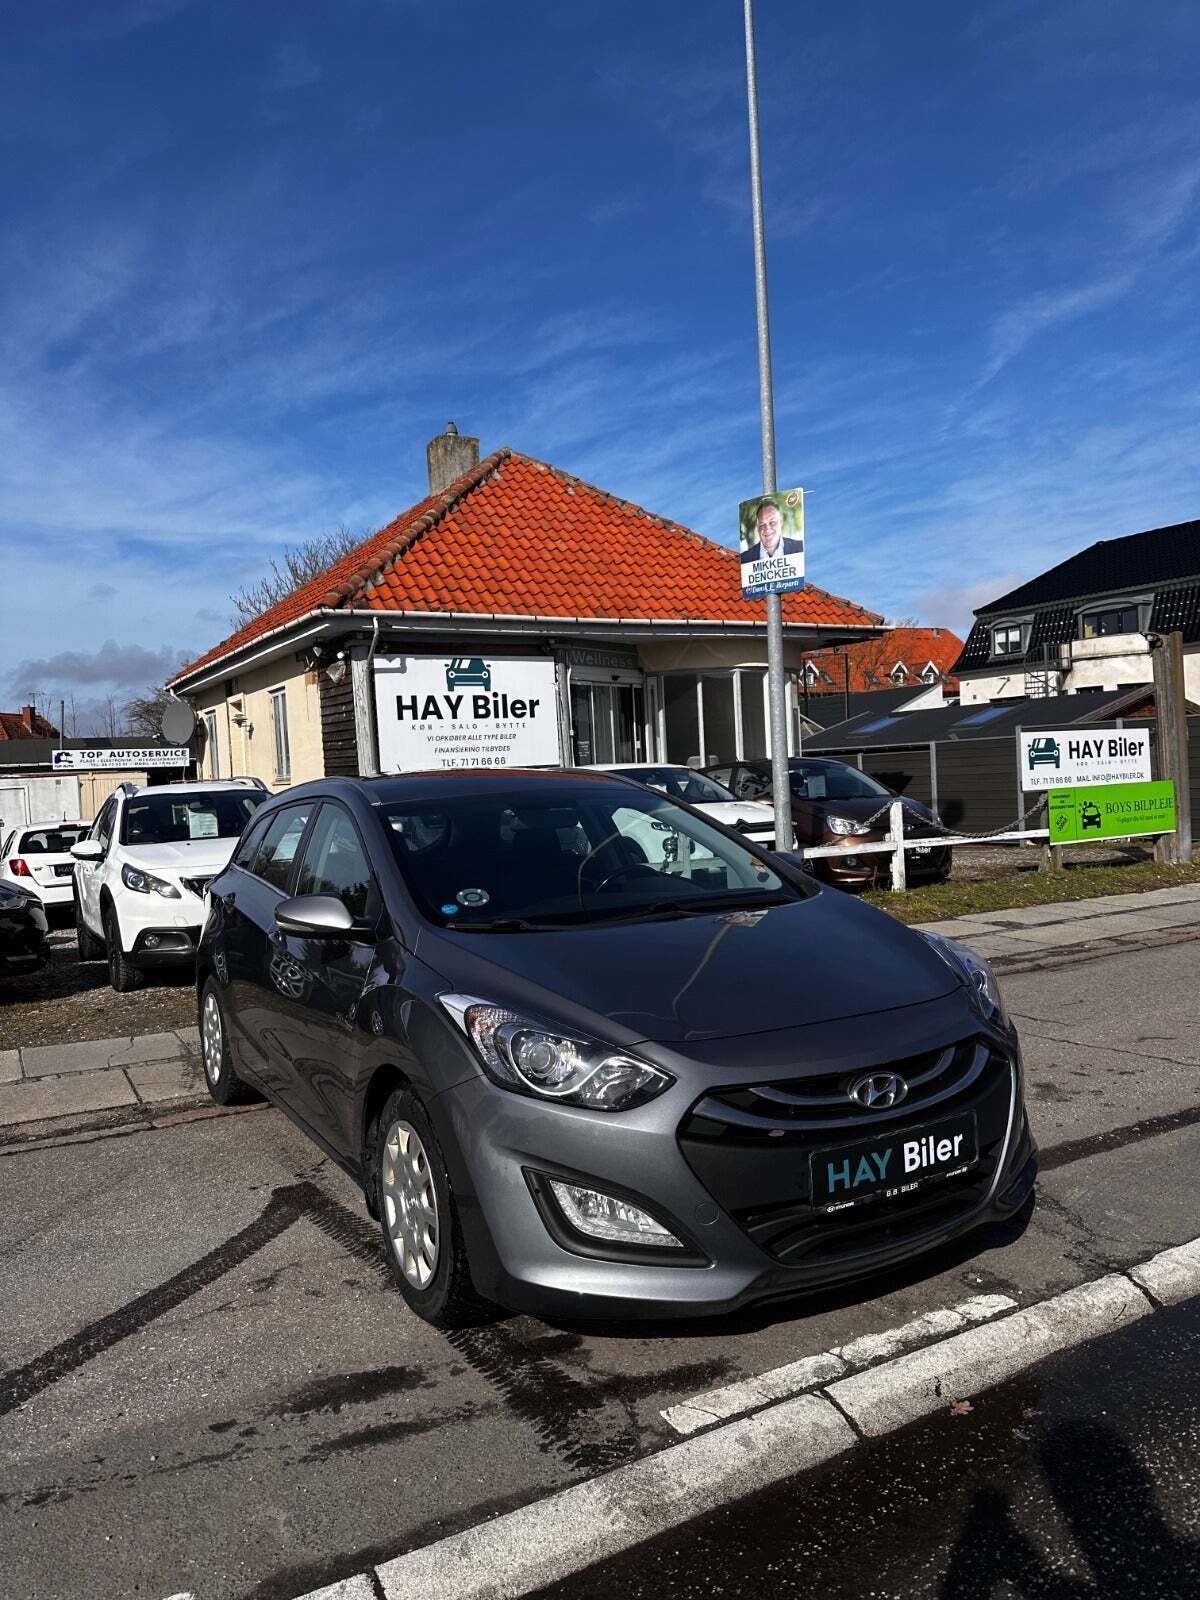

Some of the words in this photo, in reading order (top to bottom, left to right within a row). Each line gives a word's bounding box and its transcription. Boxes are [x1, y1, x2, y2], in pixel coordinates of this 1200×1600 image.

[752, 557, 790, 573] MIKKEL
[748, 566, 797, 584] DENCKER
[570, 650, 633, 667] Wellness
[396, 694, 464, 720] HAY
[472, 691, 540, 719] Biler
[482, 733, 499, 741] TYPE
[79, 751, 103, 759] TOP
[109, 749, 187, 758] AUTOSERVICE
[481, 745, 511, 753] TILBYDES
[1068, 739, 1104, 760] HAY
[1108, 736, 1145, 757] Biler
[460, 758, 469, 766] 71
[470, 757, 480, 766] 71
[481, 757, 493, 766] 66
[1106, 800, 1132, 813] BOYS
[1134, 797, 1174, 811] BILPLEJE
[826, 1148, 893, 1193] HAY
[903, 1133, 963, 1173] Biler
[901, 1182, 919, 1193] BILER
